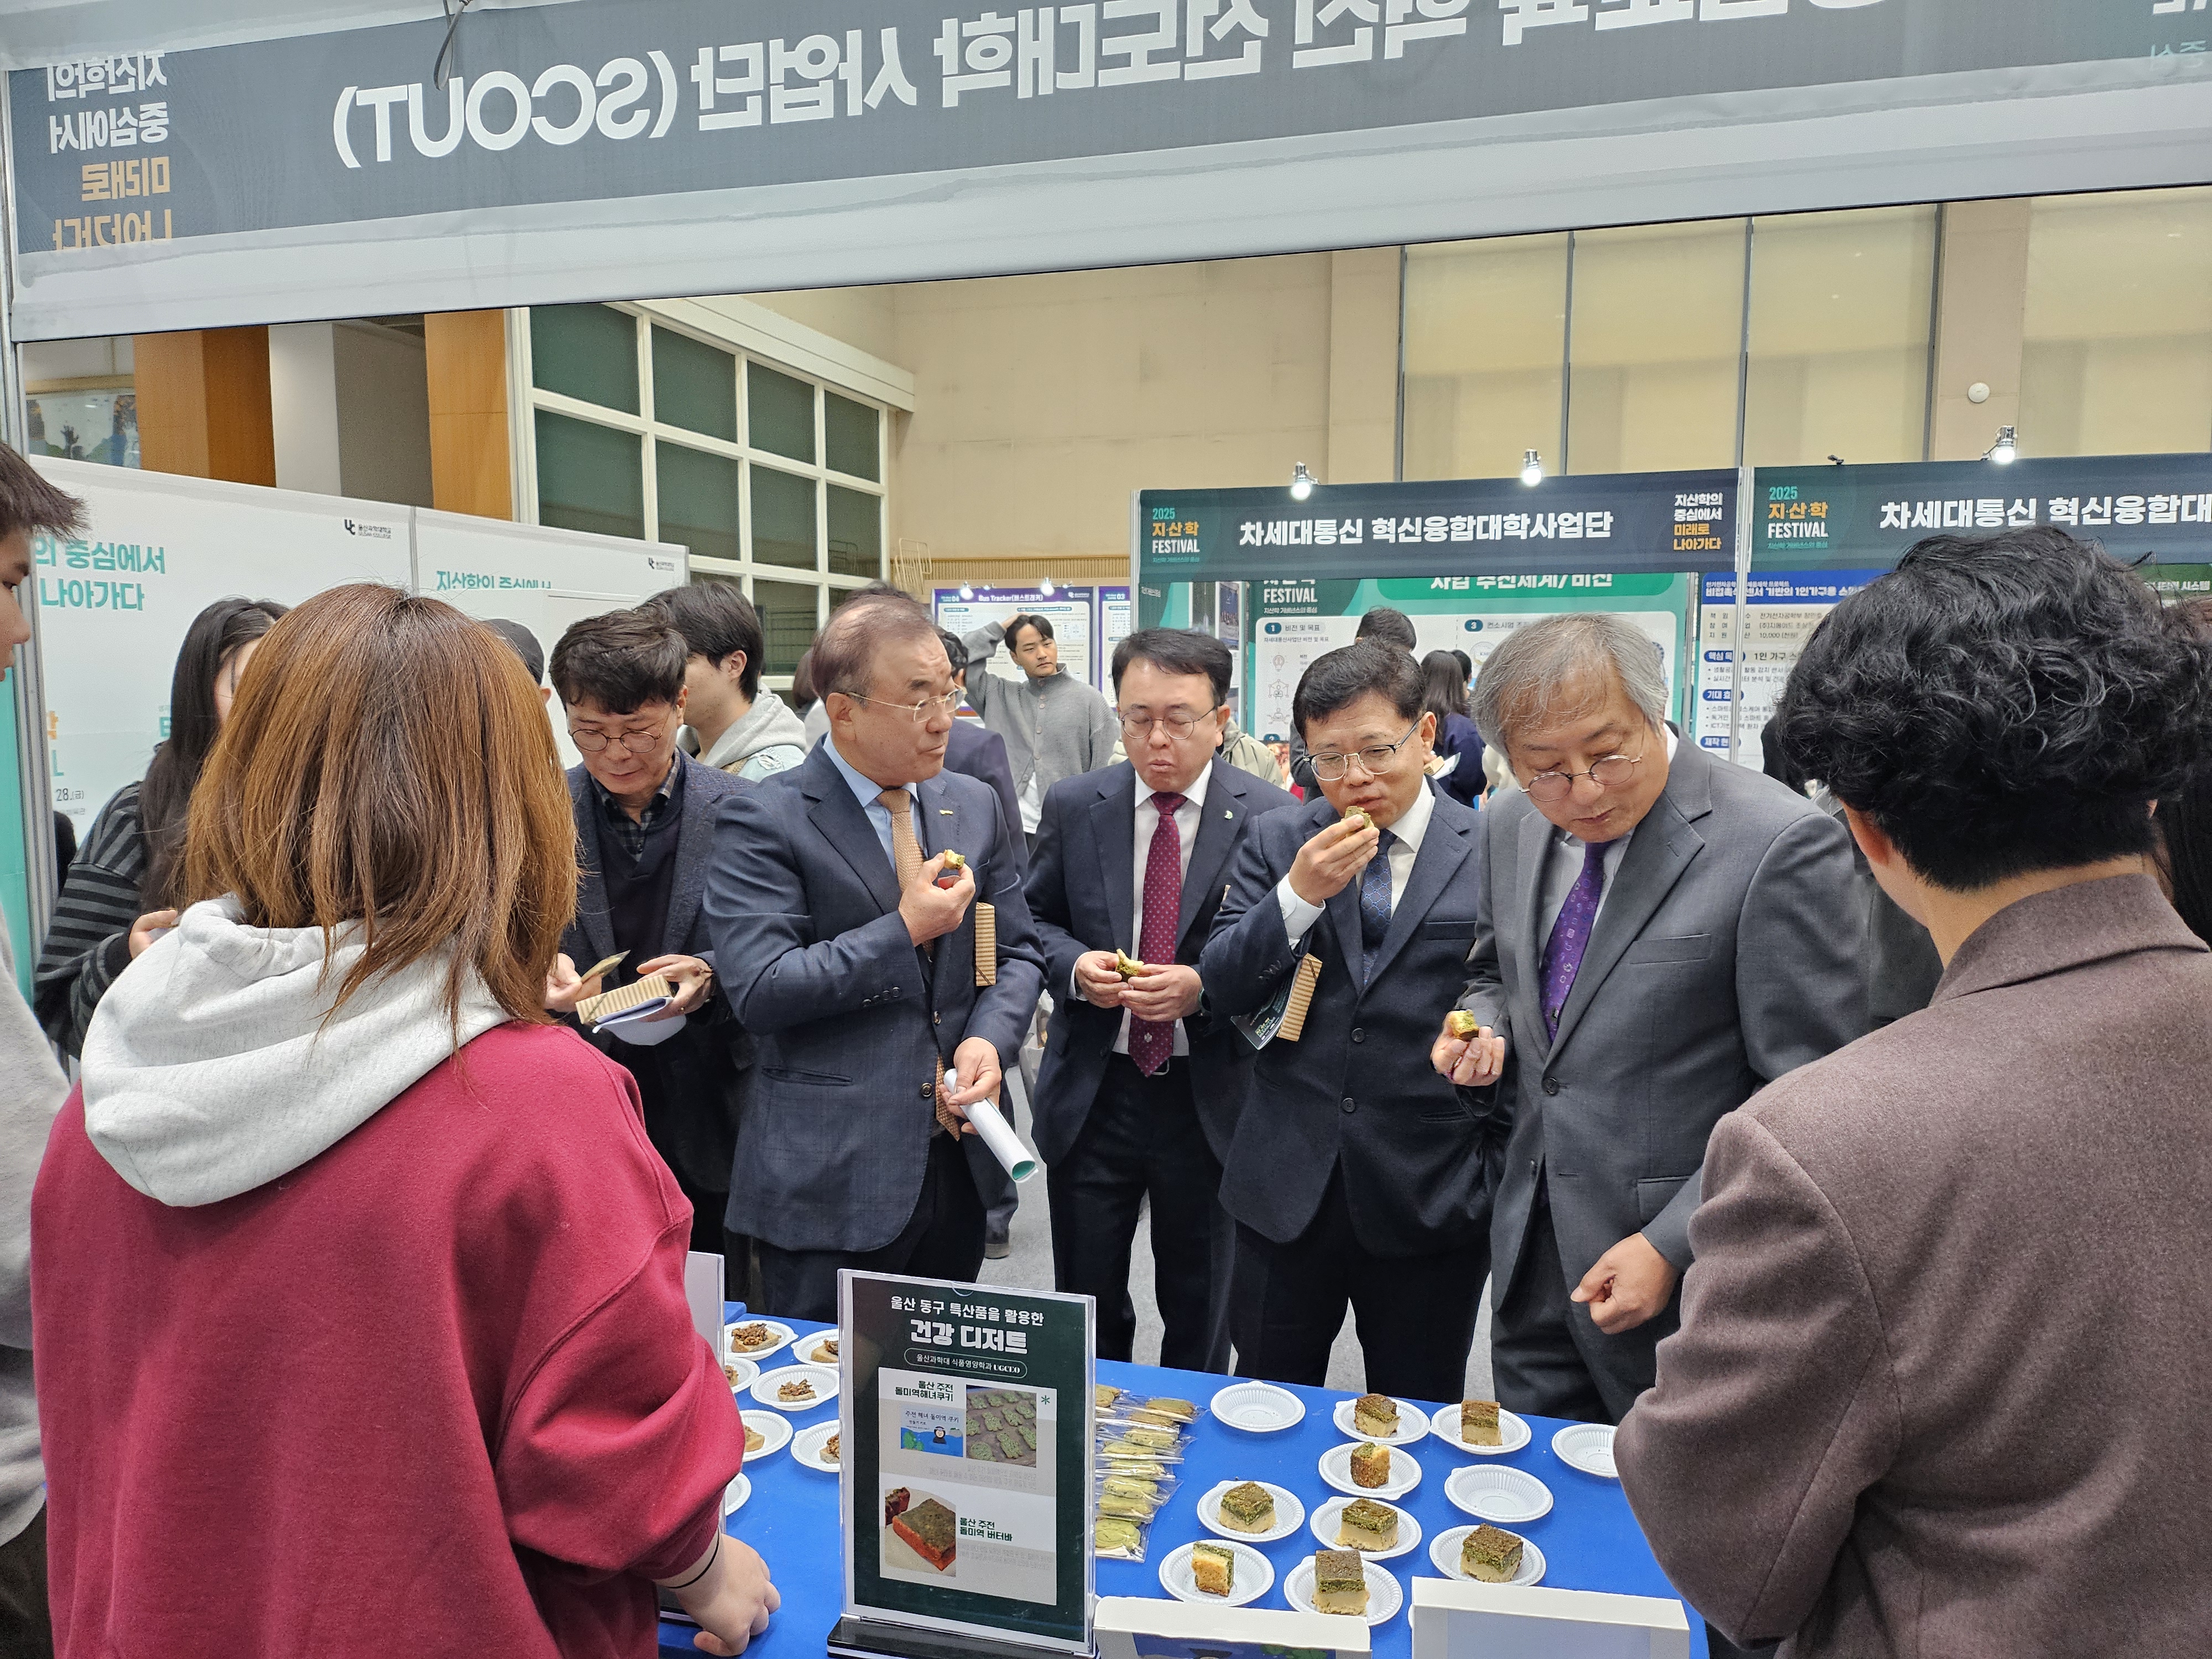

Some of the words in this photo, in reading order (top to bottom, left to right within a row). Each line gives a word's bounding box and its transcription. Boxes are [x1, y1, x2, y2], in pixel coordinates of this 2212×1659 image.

[1674, 492, 1723, 507] 지산학의
[1769, 486, 1798, 500] 2025
[1152, 508, 1176, 520] 2025
[1673, 507, 1723, 521] 중심에서
[1879, 498, 2037, 529] 차세대통신
[1239, 518, 1363, 546] 차세대통신
[1371, 510, 1614, 543] 혁신융합대학사업단
[1673, 523, 1710, 536] 미래로
[1767, 521, 1829, 539] FESTIVAL
[1152, 539, 1200, 554] FESTIVAL
[1673, 537, 1722, 551] 나아가다
[65, 540, 165, 575] 중심에서
[40, 577, 145, 611] 나아가다
[1264, 587, 1318, 603] FESTIVAL
[1754, 652, 1767, 661] 1인
[1770, 652, 1786, 660] 가구
[1707, 691, 1723, 700] 기대
[891, 1296, 916, 1311] 울산
[920, 1299, 945, 1315] 동구
[950, 1302, 1000, 1322] 특산품을
[1004, 1309, 1045, 1326] 활용한
[910, 1319, 955, 1346] 건강
[960, 1325, 1027, 1354] 디저트
[917, 1354, 950, 1365] 울산과학대
[952, 1357, 992, 1371] 식품영양학과
[937, 1383, 953, 1393] 주전
[978, 1520, 995, 1530] 주전
[987, 1530, 1013, 1542] 버터바
